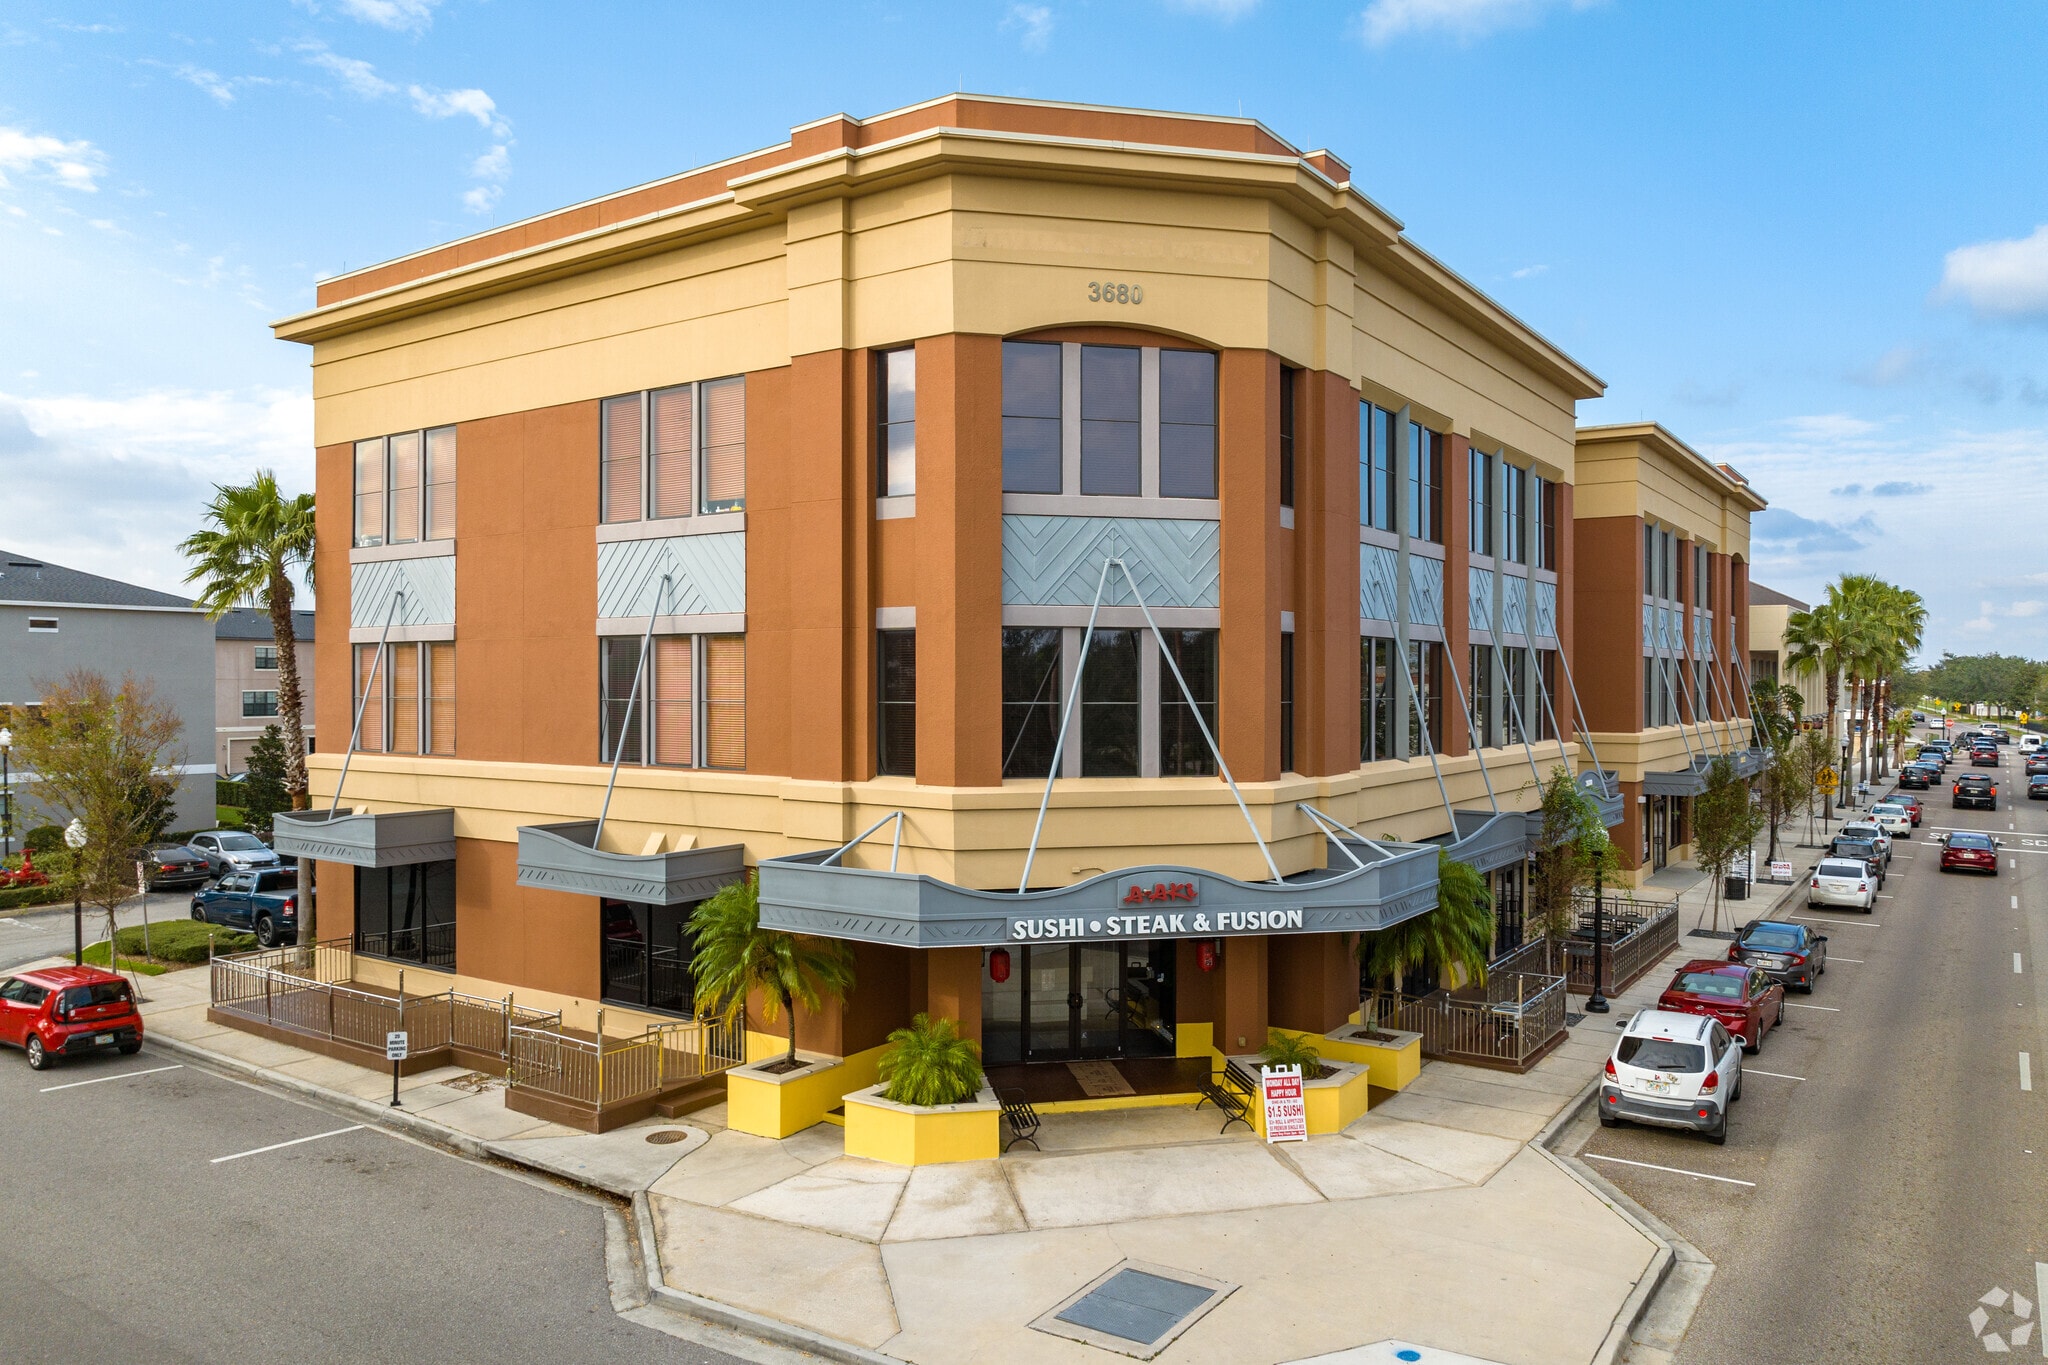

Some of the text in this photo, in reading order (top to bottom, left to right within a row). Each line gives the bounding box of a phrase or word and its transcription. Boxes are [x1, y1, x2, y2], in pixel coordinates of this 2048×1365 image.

[1088, 281, 1143, 305] 3680
[1012, 910, 1303, 940] SUSHI STEAK & FUSION
[1271, 1088, 1297, 1097] HAPPY HOUR
[1268, 1104, 1304, 1118] $1.5 SUSHI
